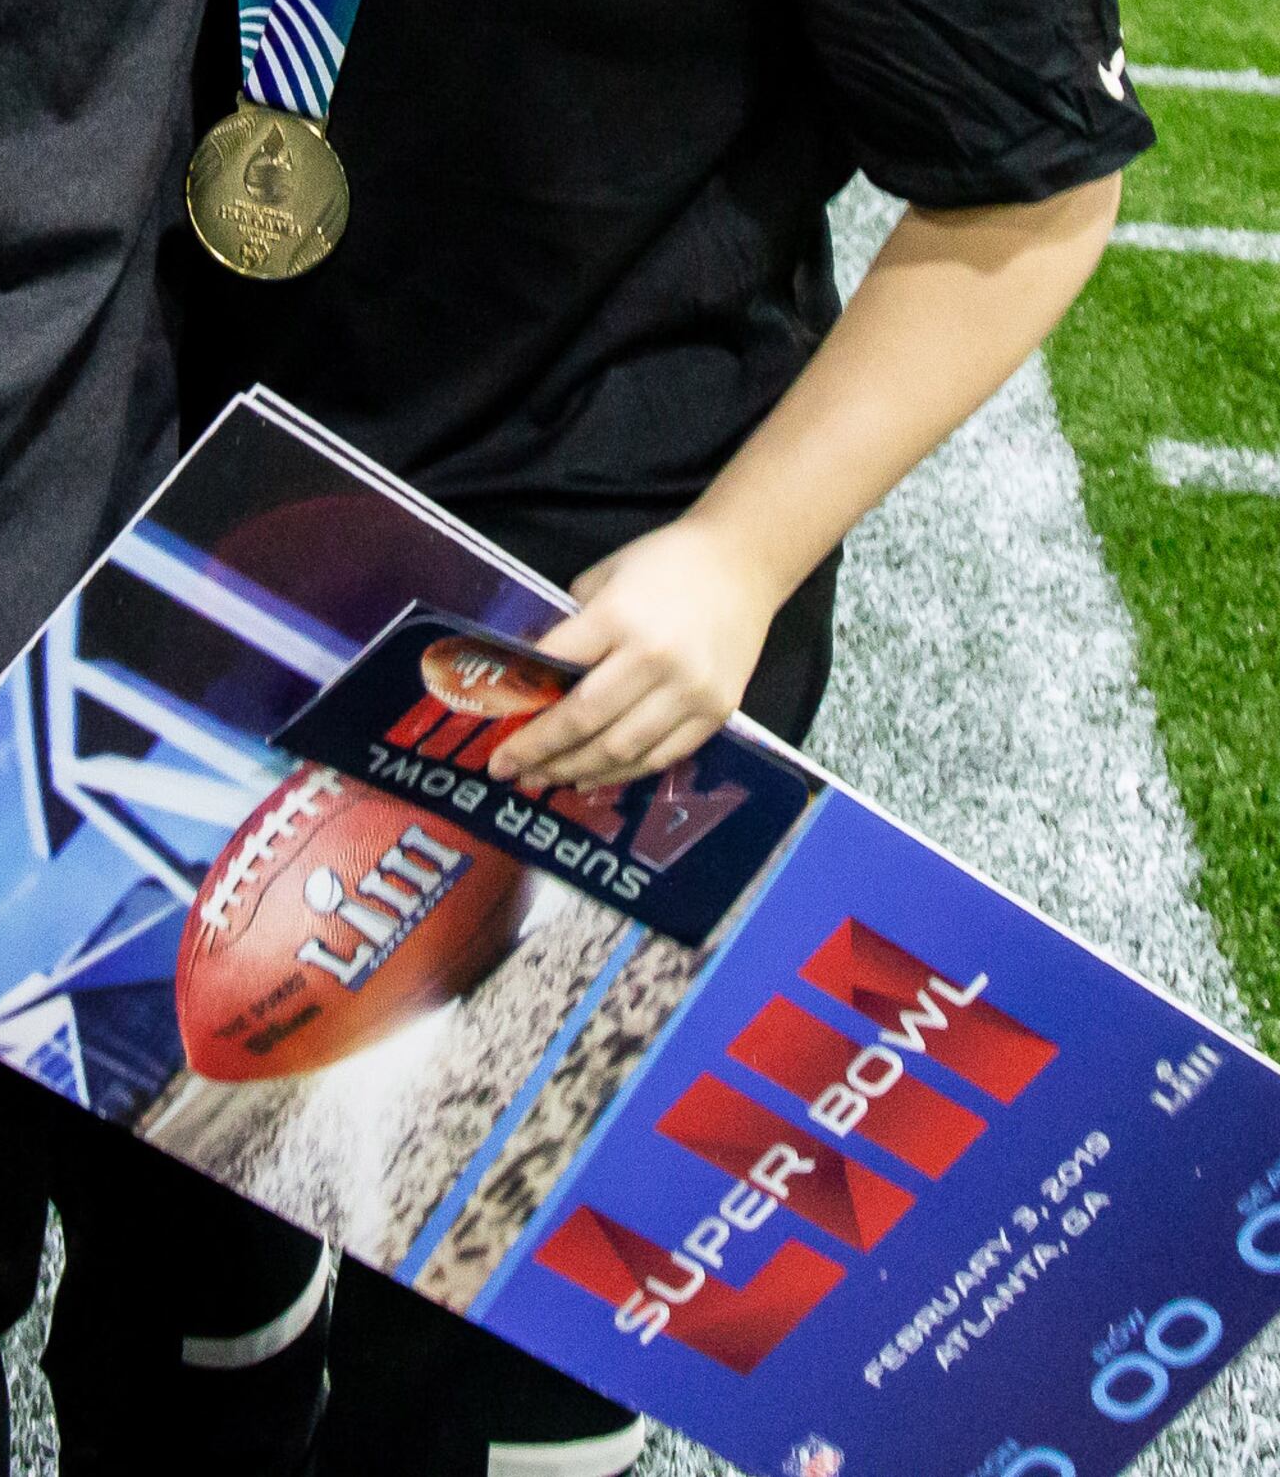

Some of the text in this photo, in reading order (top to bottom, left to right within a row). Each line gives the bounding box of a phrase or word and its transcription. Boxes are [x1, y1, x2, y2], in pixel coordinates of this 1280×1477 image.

[367, 743, 651, 901] SUPER BOWL
[614, 971, 990, 1346] SUPER BOWL
[863, 1226, 1013, 1390] FEBRUARY
[1012, 1204, 1050, 1234] 3,
[1040, 1129, 1111, 1204] 2019
[935, 1238, 1070, 1372] ATLANTA,
[1061, 1190, 1111, 1237] GA
